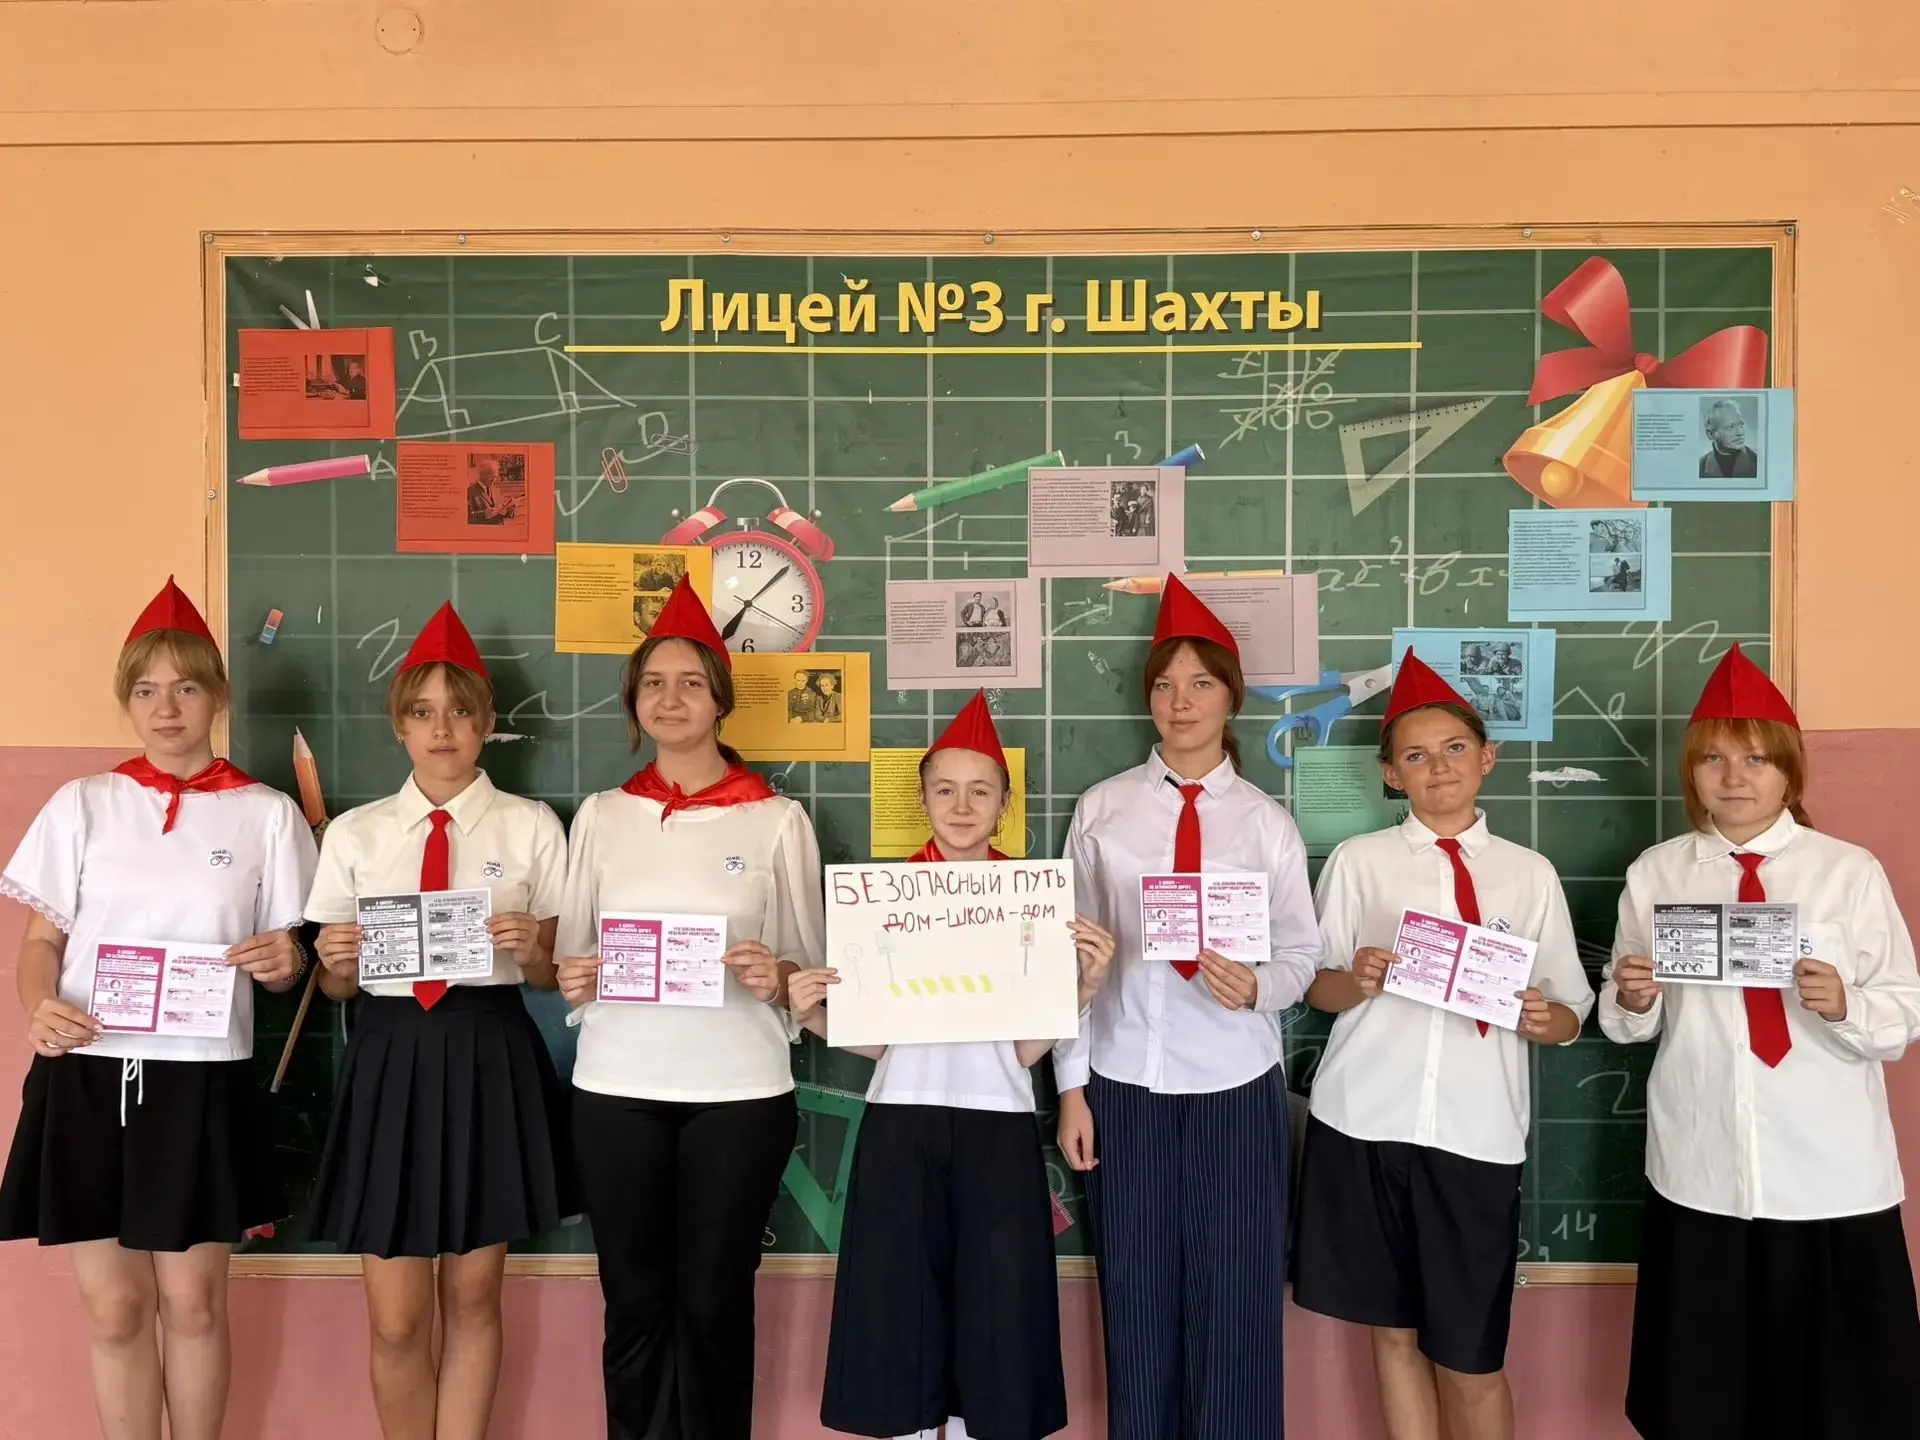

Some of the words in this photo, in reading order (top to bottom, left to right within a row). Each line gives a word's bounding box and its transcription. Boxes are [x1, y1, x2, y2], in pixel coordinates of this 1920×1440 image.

[660, 278, 878, 344] Лицей
[899, 281, 1005, 334] №3
[1026, 292, 1067, 334] г.
[1086, 279, 1321, 334] Шахты
[736, 550, 762, 569] 12
[791, 594, 804, 613] 3
[741, 638, 755, 653] 6
[833, 865, 1001, 905] БЕЗОПАСНЫЙ
[1014, 869, 1066, 895] ПУТЬ
